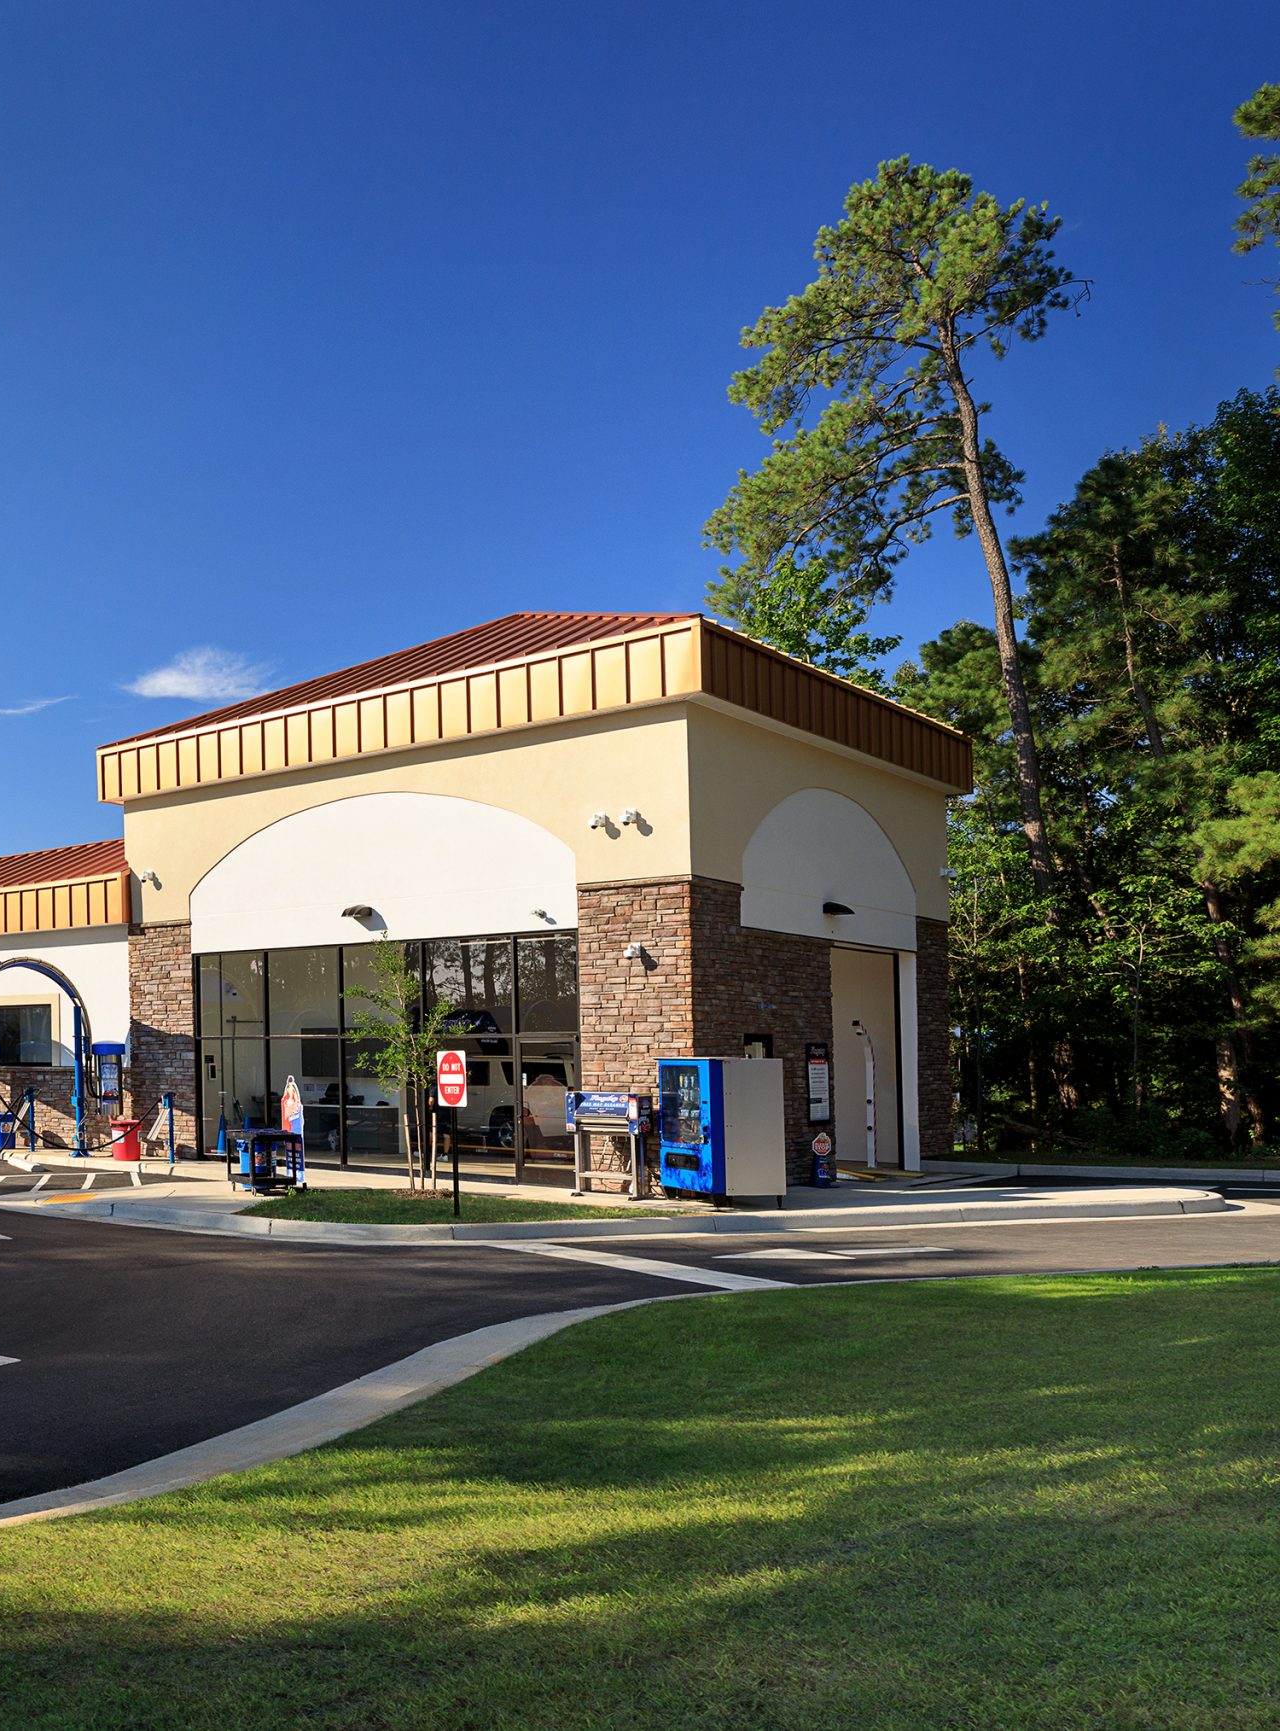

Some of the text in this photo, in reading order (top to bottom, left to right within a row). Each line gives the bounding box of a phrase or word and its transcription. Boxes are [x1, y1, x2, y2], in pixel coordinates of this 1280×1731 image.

[442, 1063, 461, 1071] DO NOT
[444, 1086, 460, 1094] ENTER
